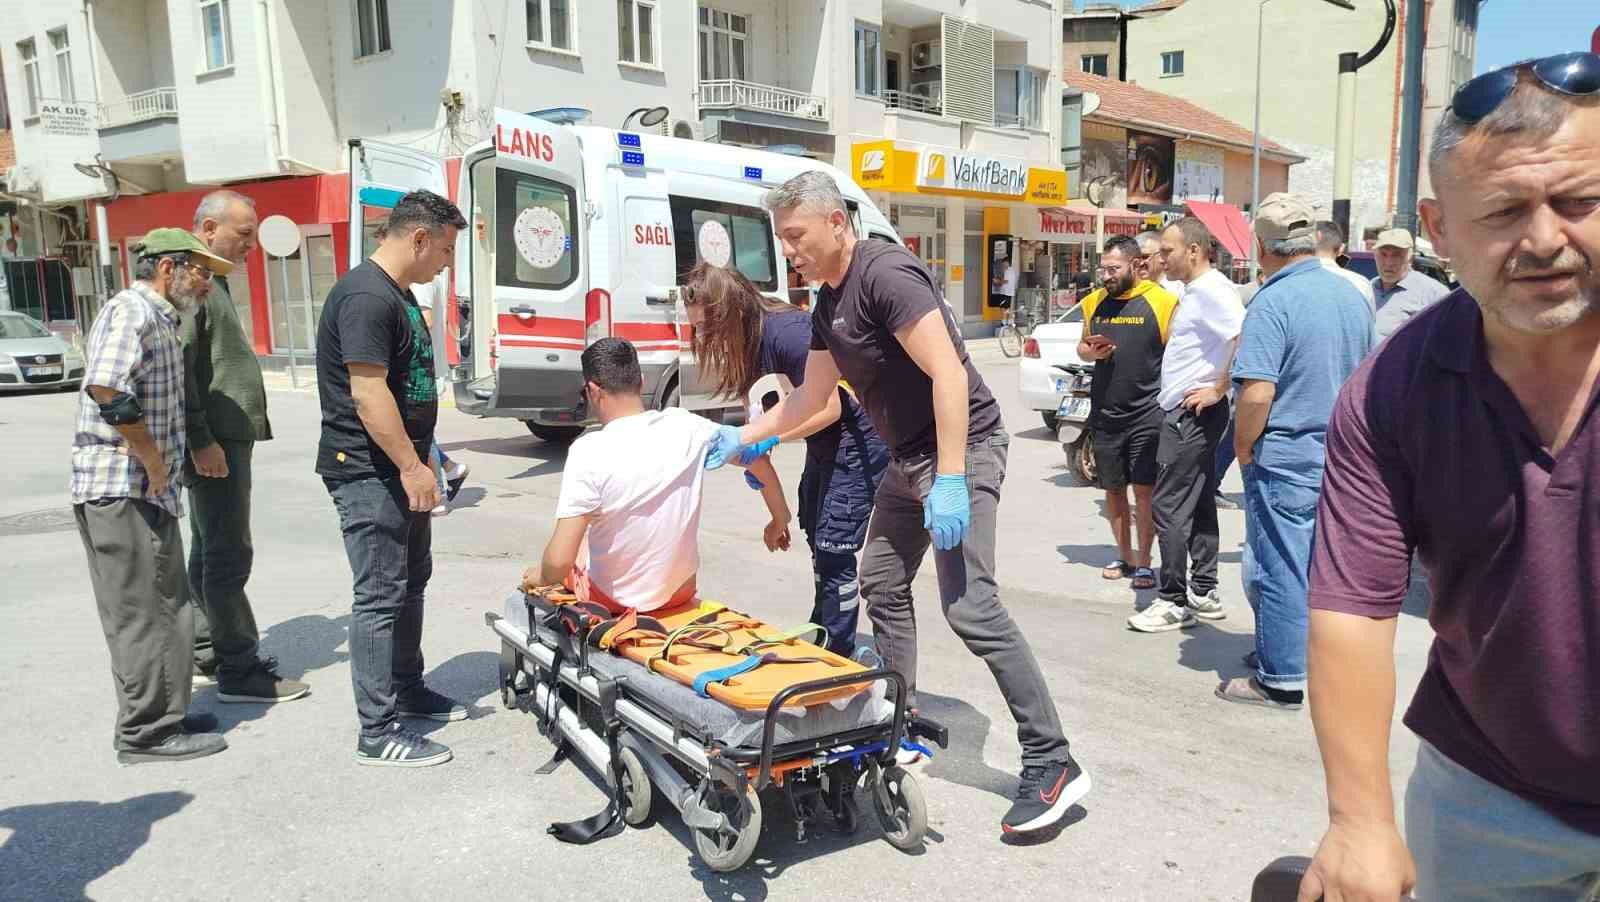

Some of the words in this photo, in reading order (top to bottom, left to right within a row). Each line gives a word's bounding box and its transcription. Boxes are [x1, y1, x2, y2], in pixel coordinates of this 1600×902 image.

[497, 124, 553, 162] LANS
[635, 222, 672, 246] SAĞL
[1040, 211, 1086, 234] Merkez
